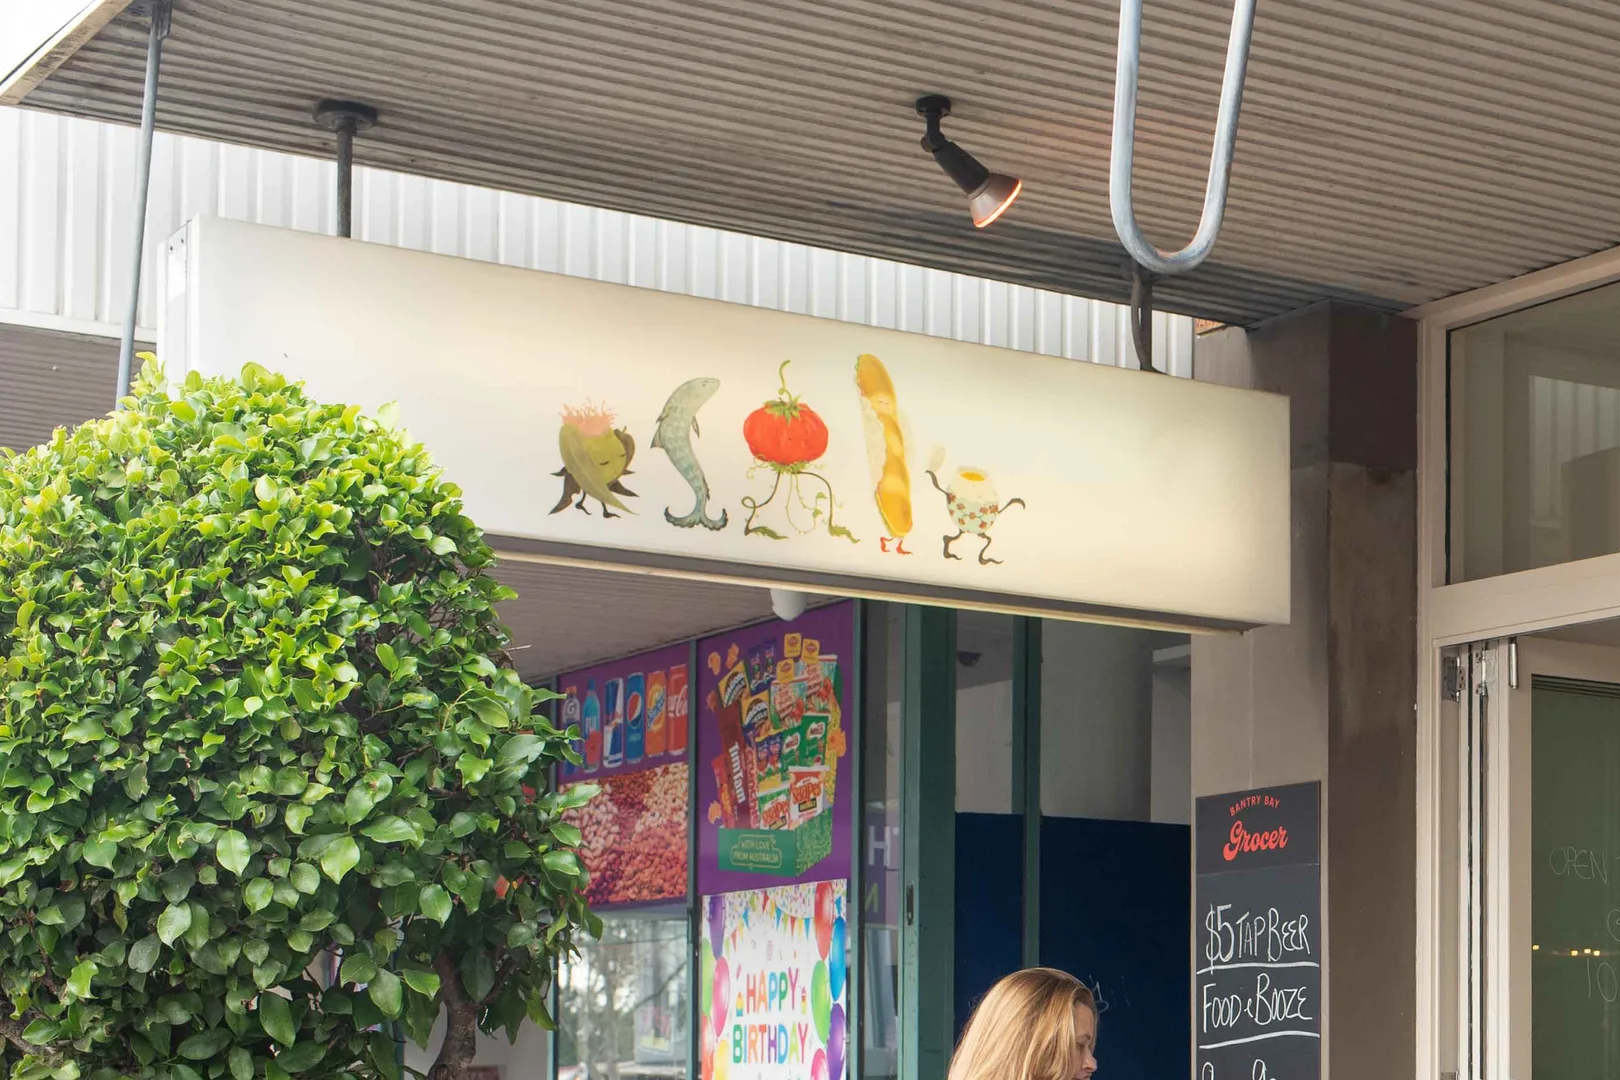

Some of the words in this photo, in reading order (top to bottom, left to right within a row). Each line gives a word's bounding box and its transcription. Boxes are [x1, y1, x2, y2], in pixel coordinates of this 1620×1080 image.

[1229, 794, 1261, 817] BANTRY
[1264, 795, 1280, 808] BAY
[1223, 820, 1288, 861] Grocer
[1550, 846, 1608, 885] OPEN
[746, 967, 799, 1014] HAPPY
[1203, 982, 1242, 1034] FOOD
[1254, 972, 1314, 1026] BOOZE
[732, 1022, 809, 1065] BIRTHDAY
